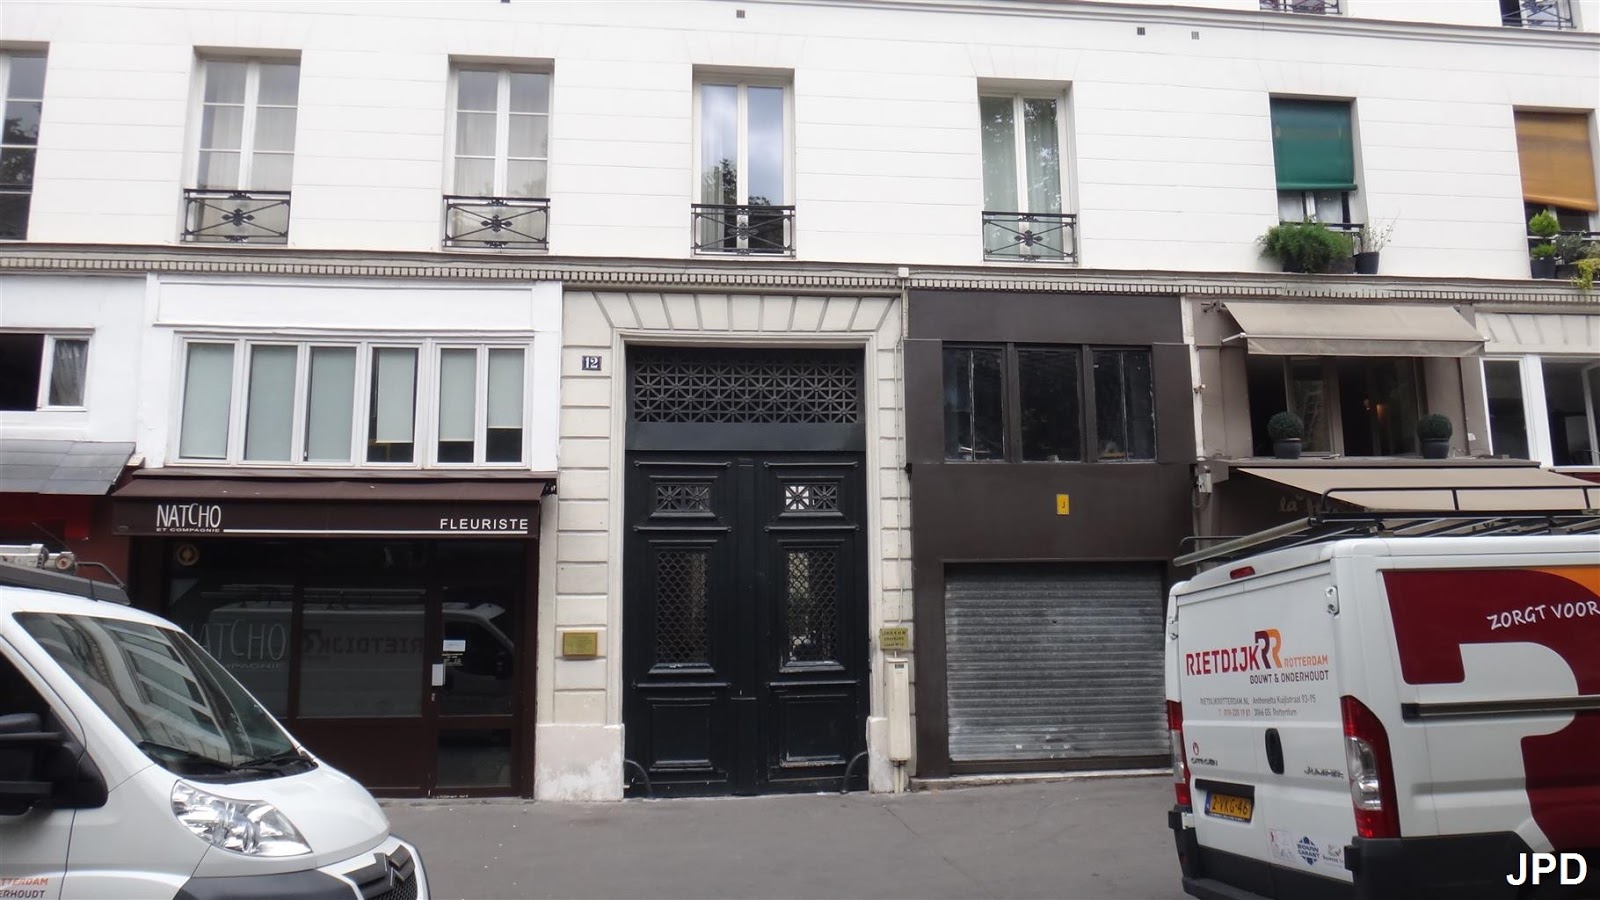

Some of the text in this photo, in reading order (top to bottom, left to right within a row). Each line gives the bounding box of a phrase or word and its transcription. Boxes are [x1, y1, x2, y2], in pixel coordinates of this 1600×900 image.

[585, 356, 598, 369] 12
[156, 503, 221, 528] NATCHO
[440, 518, 528, 530] FLEURISTE
[1487, 600, 1600, 630] ZORGT VOOR
[190, 619, 286, 661] ATCHO
[1186, 645, 1260, 676] RIETDIJK
[1284, 655, 1328, 668] ROTTERDAM
[1275, 672, 1279, 682] &
[1281, 670, 1329, 681] ONDERHOUDT
